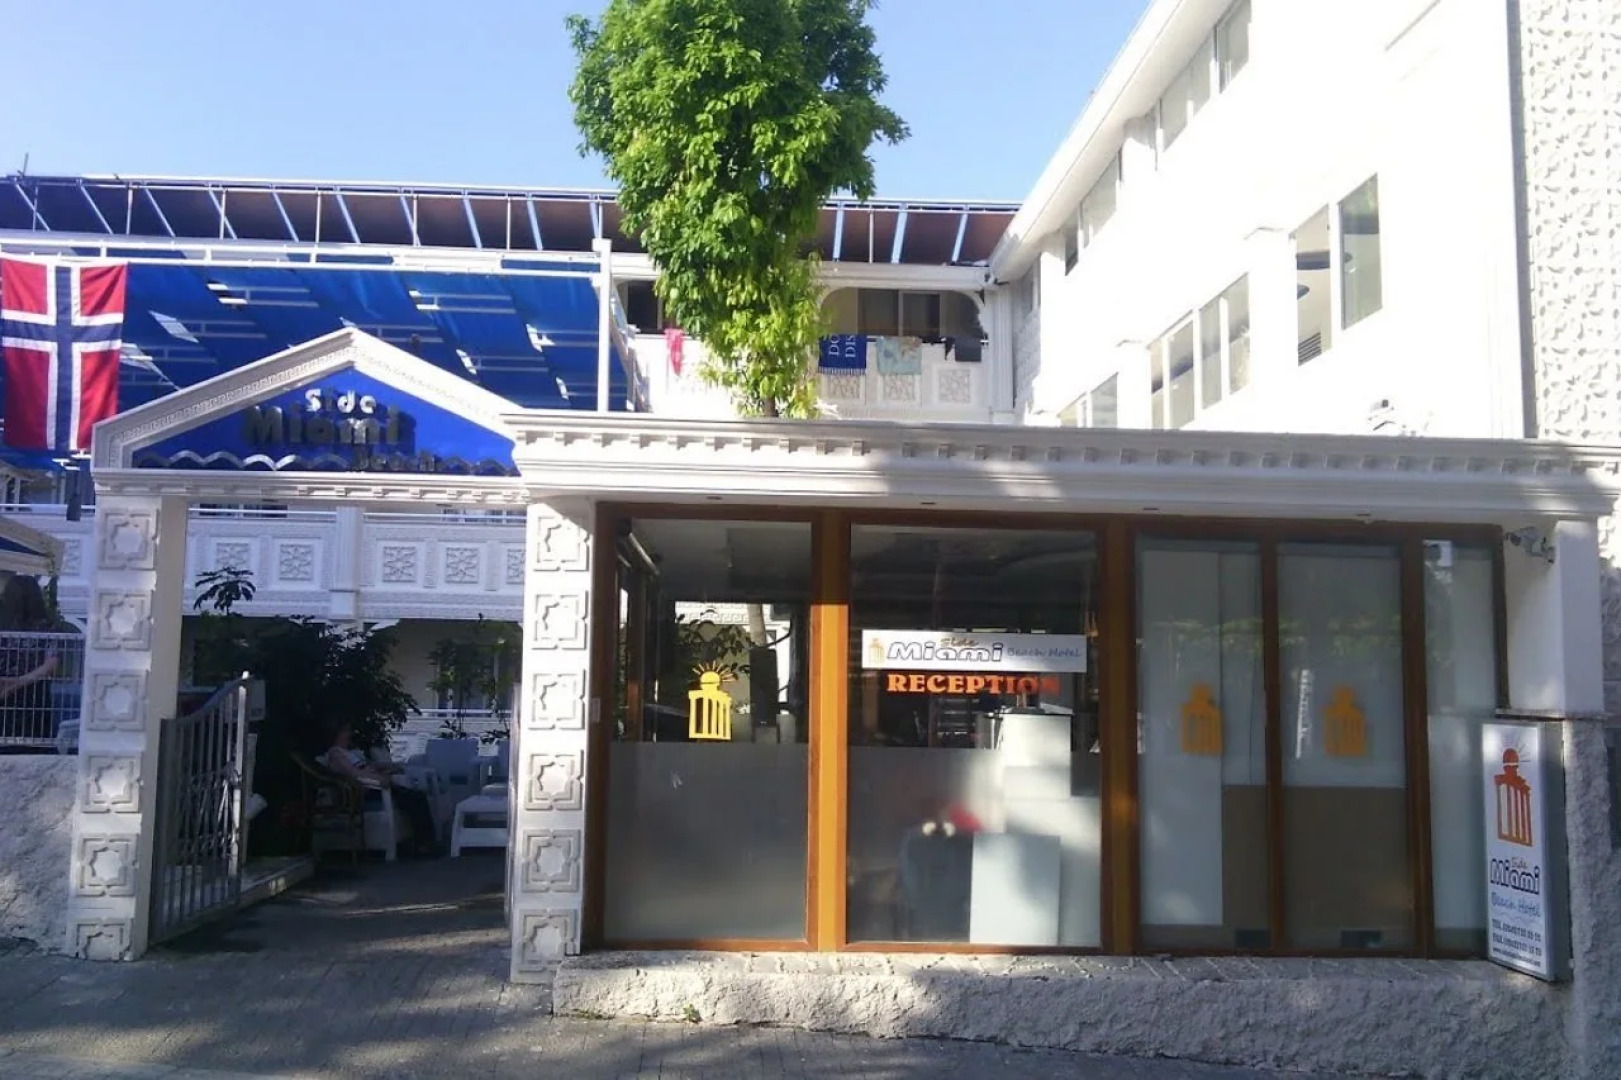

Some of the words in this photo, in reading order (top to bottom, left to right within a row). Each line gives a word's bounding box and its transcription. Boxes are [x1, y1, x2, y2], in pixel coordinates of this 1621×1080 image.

[304, 387, 377, 414] Side
[246, 404, 400, 444] Miami
[887, 641, 1004, 663] Miami
[1006, 646, 1046, 658] Beach
[1048, 647, 1082, 659] Hotel
[940, 636, 980, 648] Side
[886, 673, 1061, 695] RECEPTION
[1490, 858, 1540, 895] Miami
